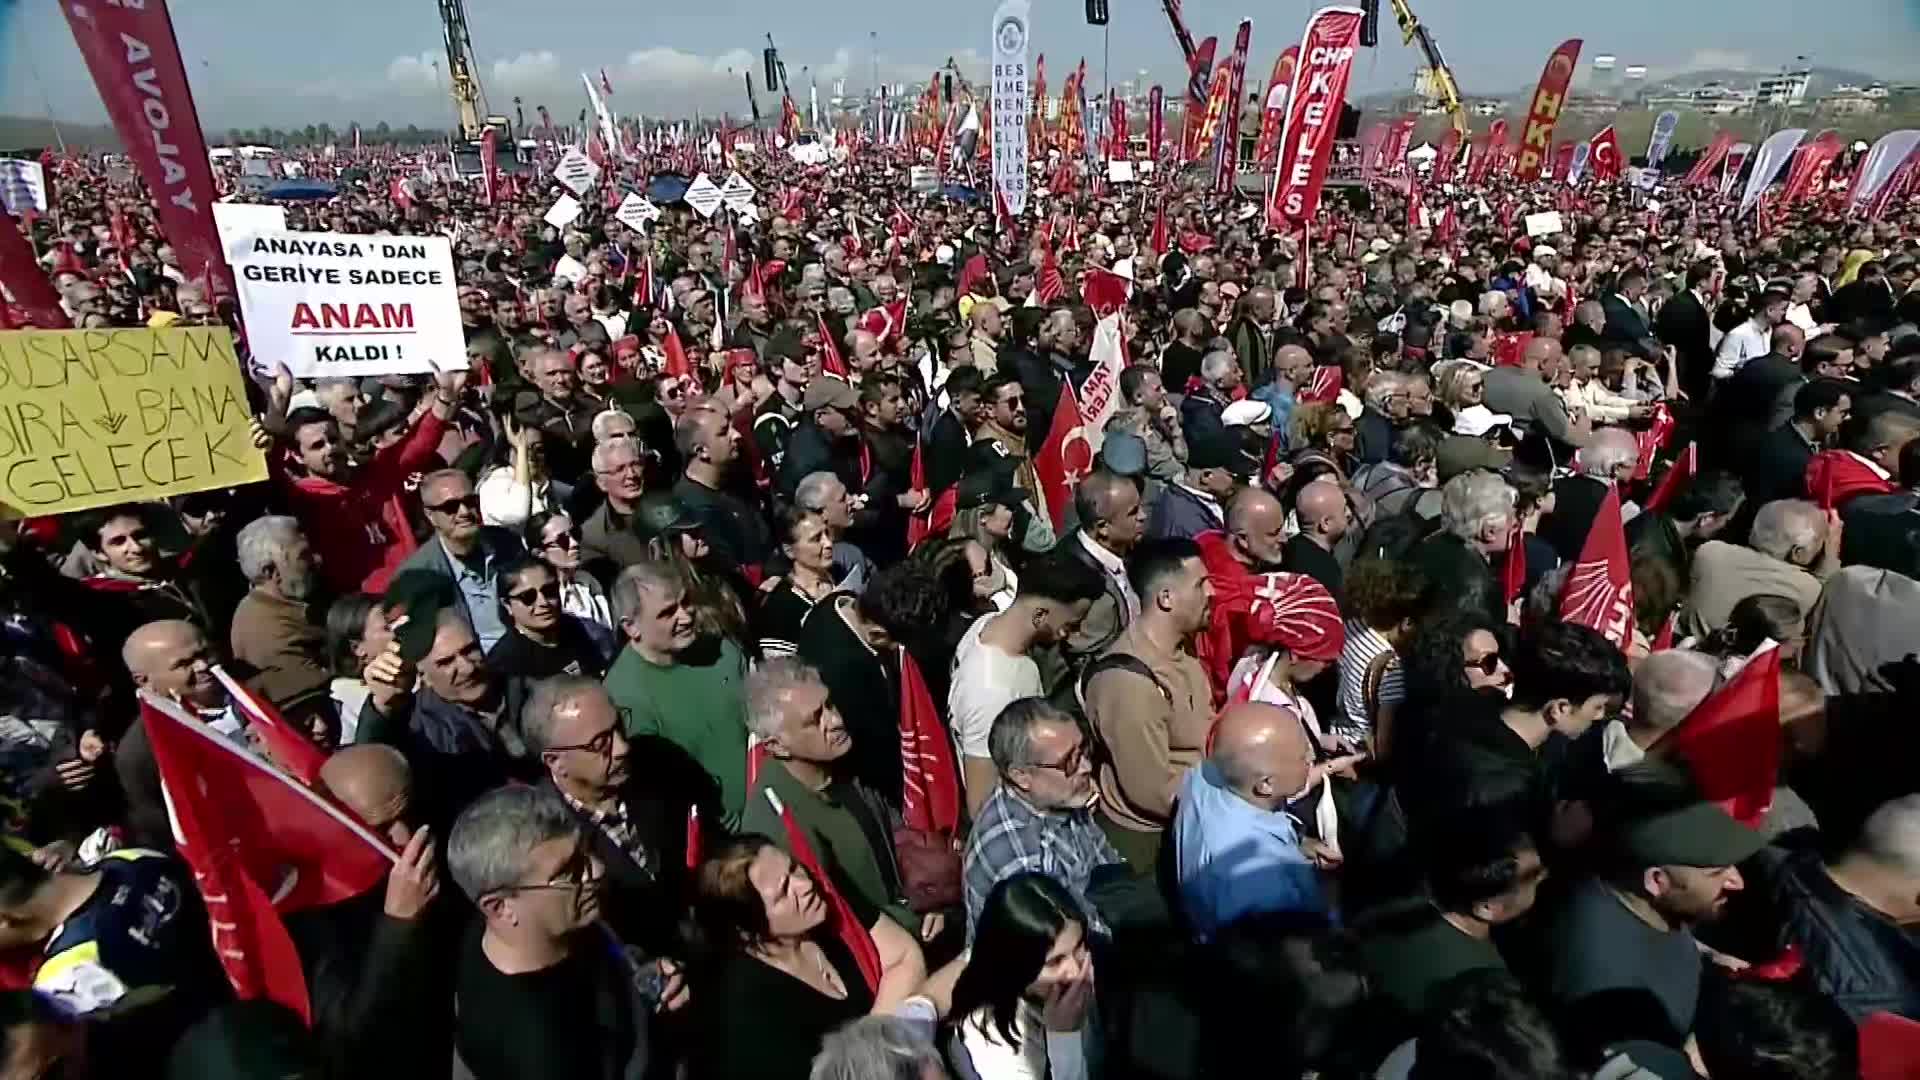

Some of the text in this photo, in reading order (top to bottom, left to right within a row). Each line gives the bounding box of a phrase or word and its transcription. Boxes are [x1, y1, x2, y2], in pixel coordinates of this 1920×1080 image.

[1310, 47, 1353, 65] CHP
[1284, 72, 1330, 215] KELES
[1518, 89, 1561, 173] HKP
[243, 264, 443, 285] GERİYE SADECE
[291, 302, 415, 328] ANAM
[135, 384, 251, 436] BANA
[6, 427, 249, 504] GELECEK
